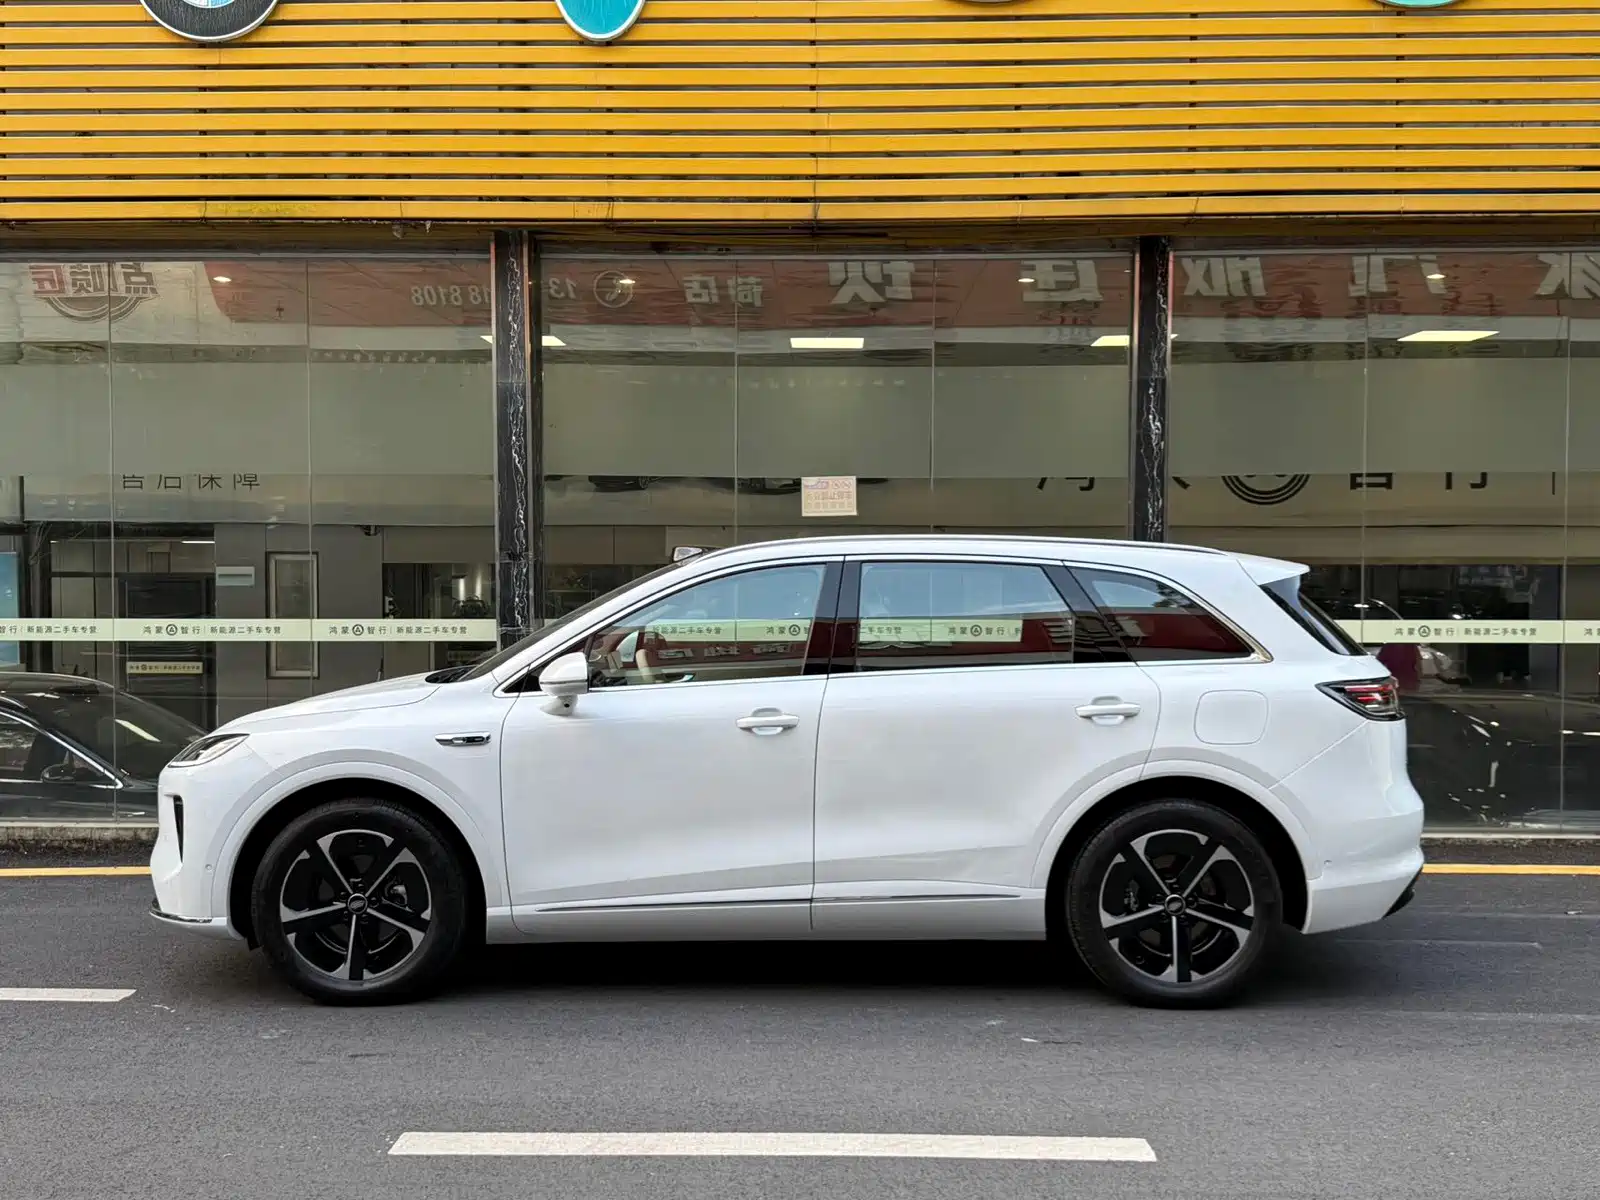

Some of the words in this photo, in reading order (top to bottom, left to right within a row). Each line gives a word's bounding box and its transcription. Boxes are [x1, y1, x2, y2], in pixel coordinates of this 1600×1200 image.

[210, 625, 282, 635] 新能源二手车专营
[396, 625, 467, 635] 新能源二手车专营
